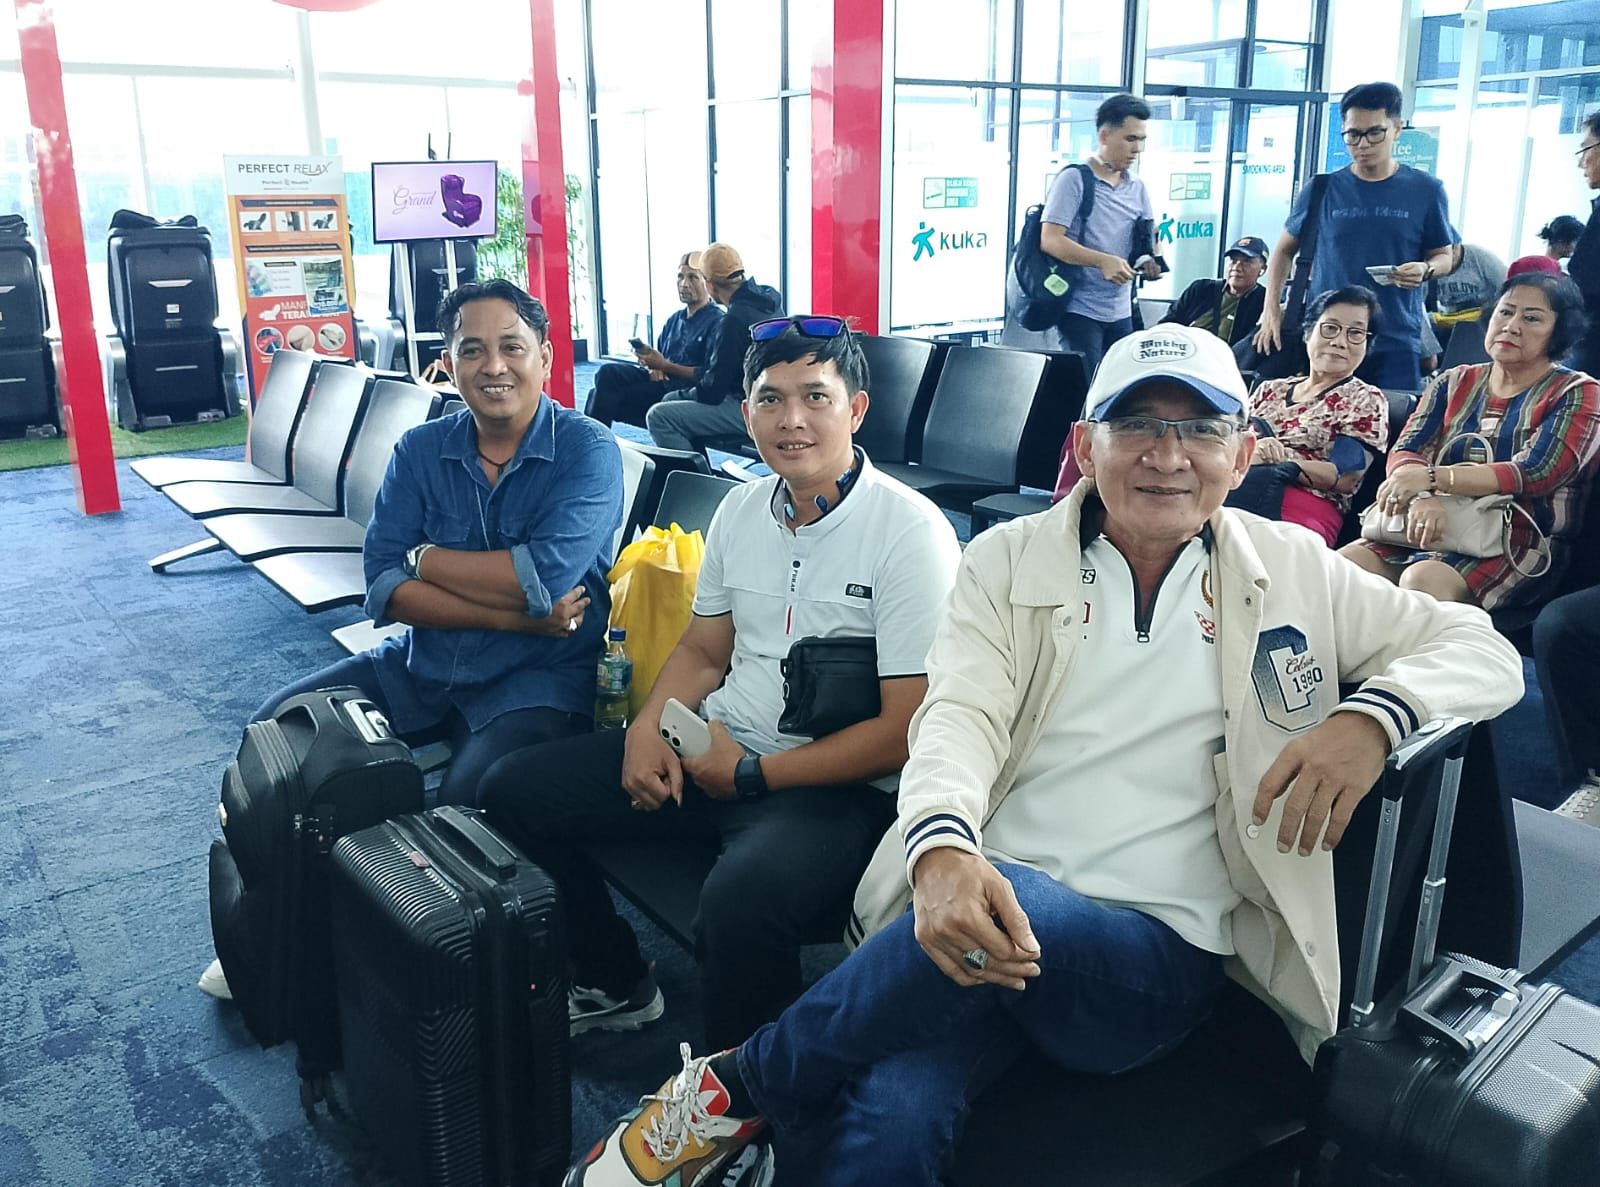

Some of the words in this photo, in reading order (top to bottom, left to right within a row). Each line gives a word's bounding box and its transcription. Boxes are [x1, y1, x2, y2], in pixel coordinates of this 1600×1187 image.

[238, 163, 290, 174] PERFECT
[293, 161, 333, 176] RELAX
[391, 185, 437, 216] Grand
[1176, 220, 1214, 239] kuka
[940, 230, 988, 251] kuka
[1292, 667, 1323, 693] 1980
